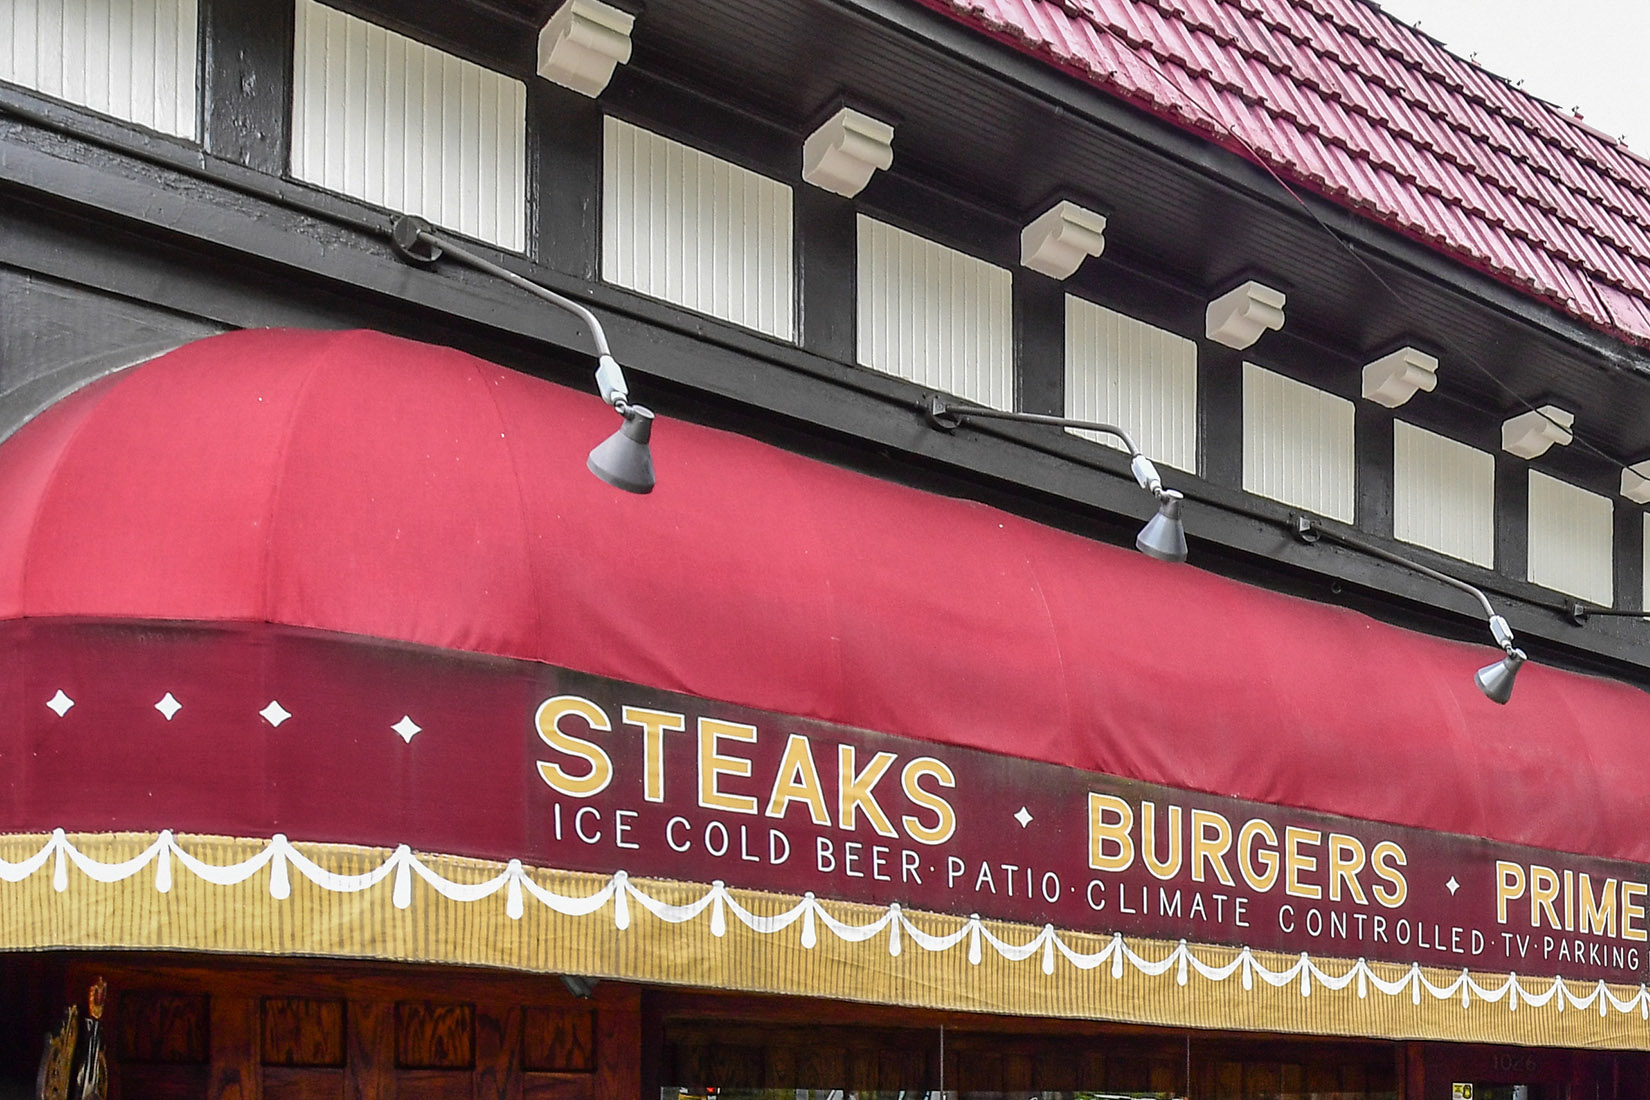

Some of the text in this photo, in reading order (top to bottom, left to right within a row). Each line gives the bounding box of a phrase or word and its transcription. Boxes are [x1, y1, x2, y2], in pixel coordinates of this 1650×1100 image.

[535, 695, 957, 846] STEAKS
[554, 803, 640, 849] ICE
[666, 815, 791, 866] COLD
[815, 836, 923, 885] BEER
[947, 856, 1061, 903] PATIO
[1086, 880, 1250, 928] CLIMATE
[1278, 905, 1485, 955] CONTROLLED
[1501, 932, 1531, 959] TV
[1543, 937, 1639, 971] PARKING
[1087, 791, 1410, 909] BURGERS
[1495, 860, 1649, 943] PRIME
